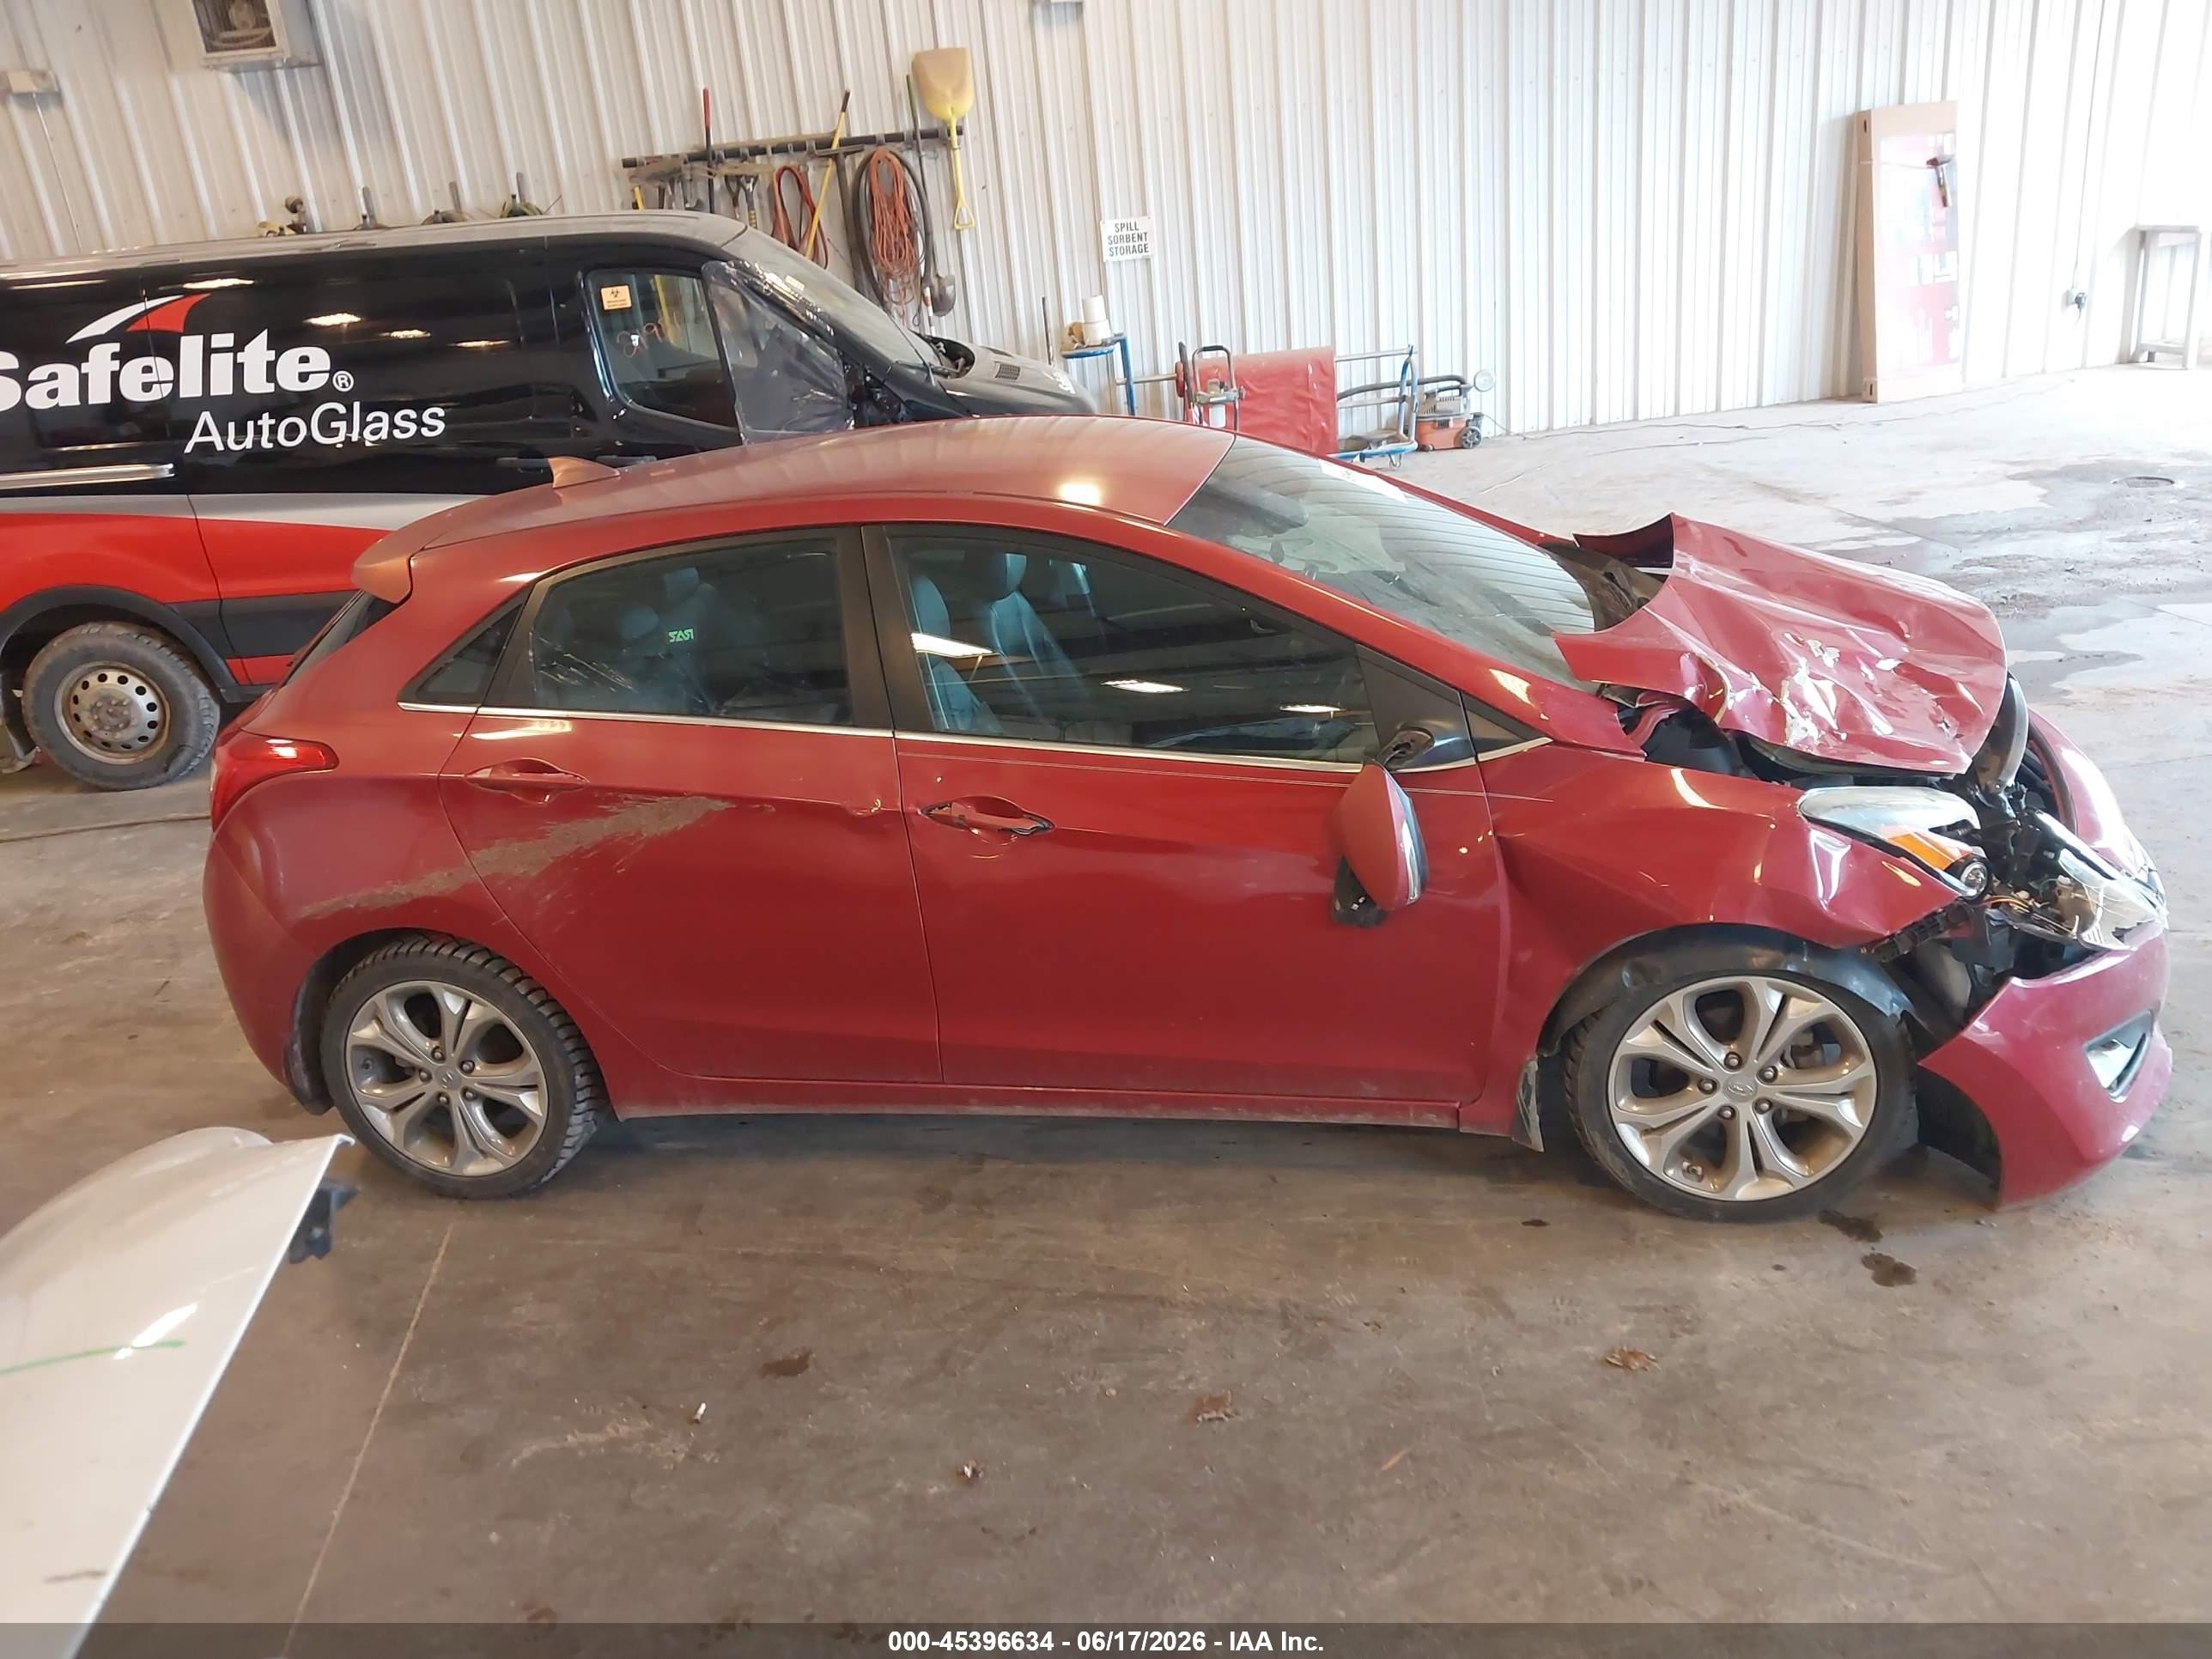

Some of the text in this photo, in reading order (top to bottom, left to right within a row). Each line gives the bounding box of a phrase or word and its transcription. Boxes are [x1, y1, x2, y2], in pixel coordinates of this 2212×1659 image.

[1115, 220, 1139, 234] SPILL
[1108, 231, 1148, 246] SORBENT
[1109, 243, 1150, 258] STORAGE
[183, 400, 446, 454] AutoGlass
